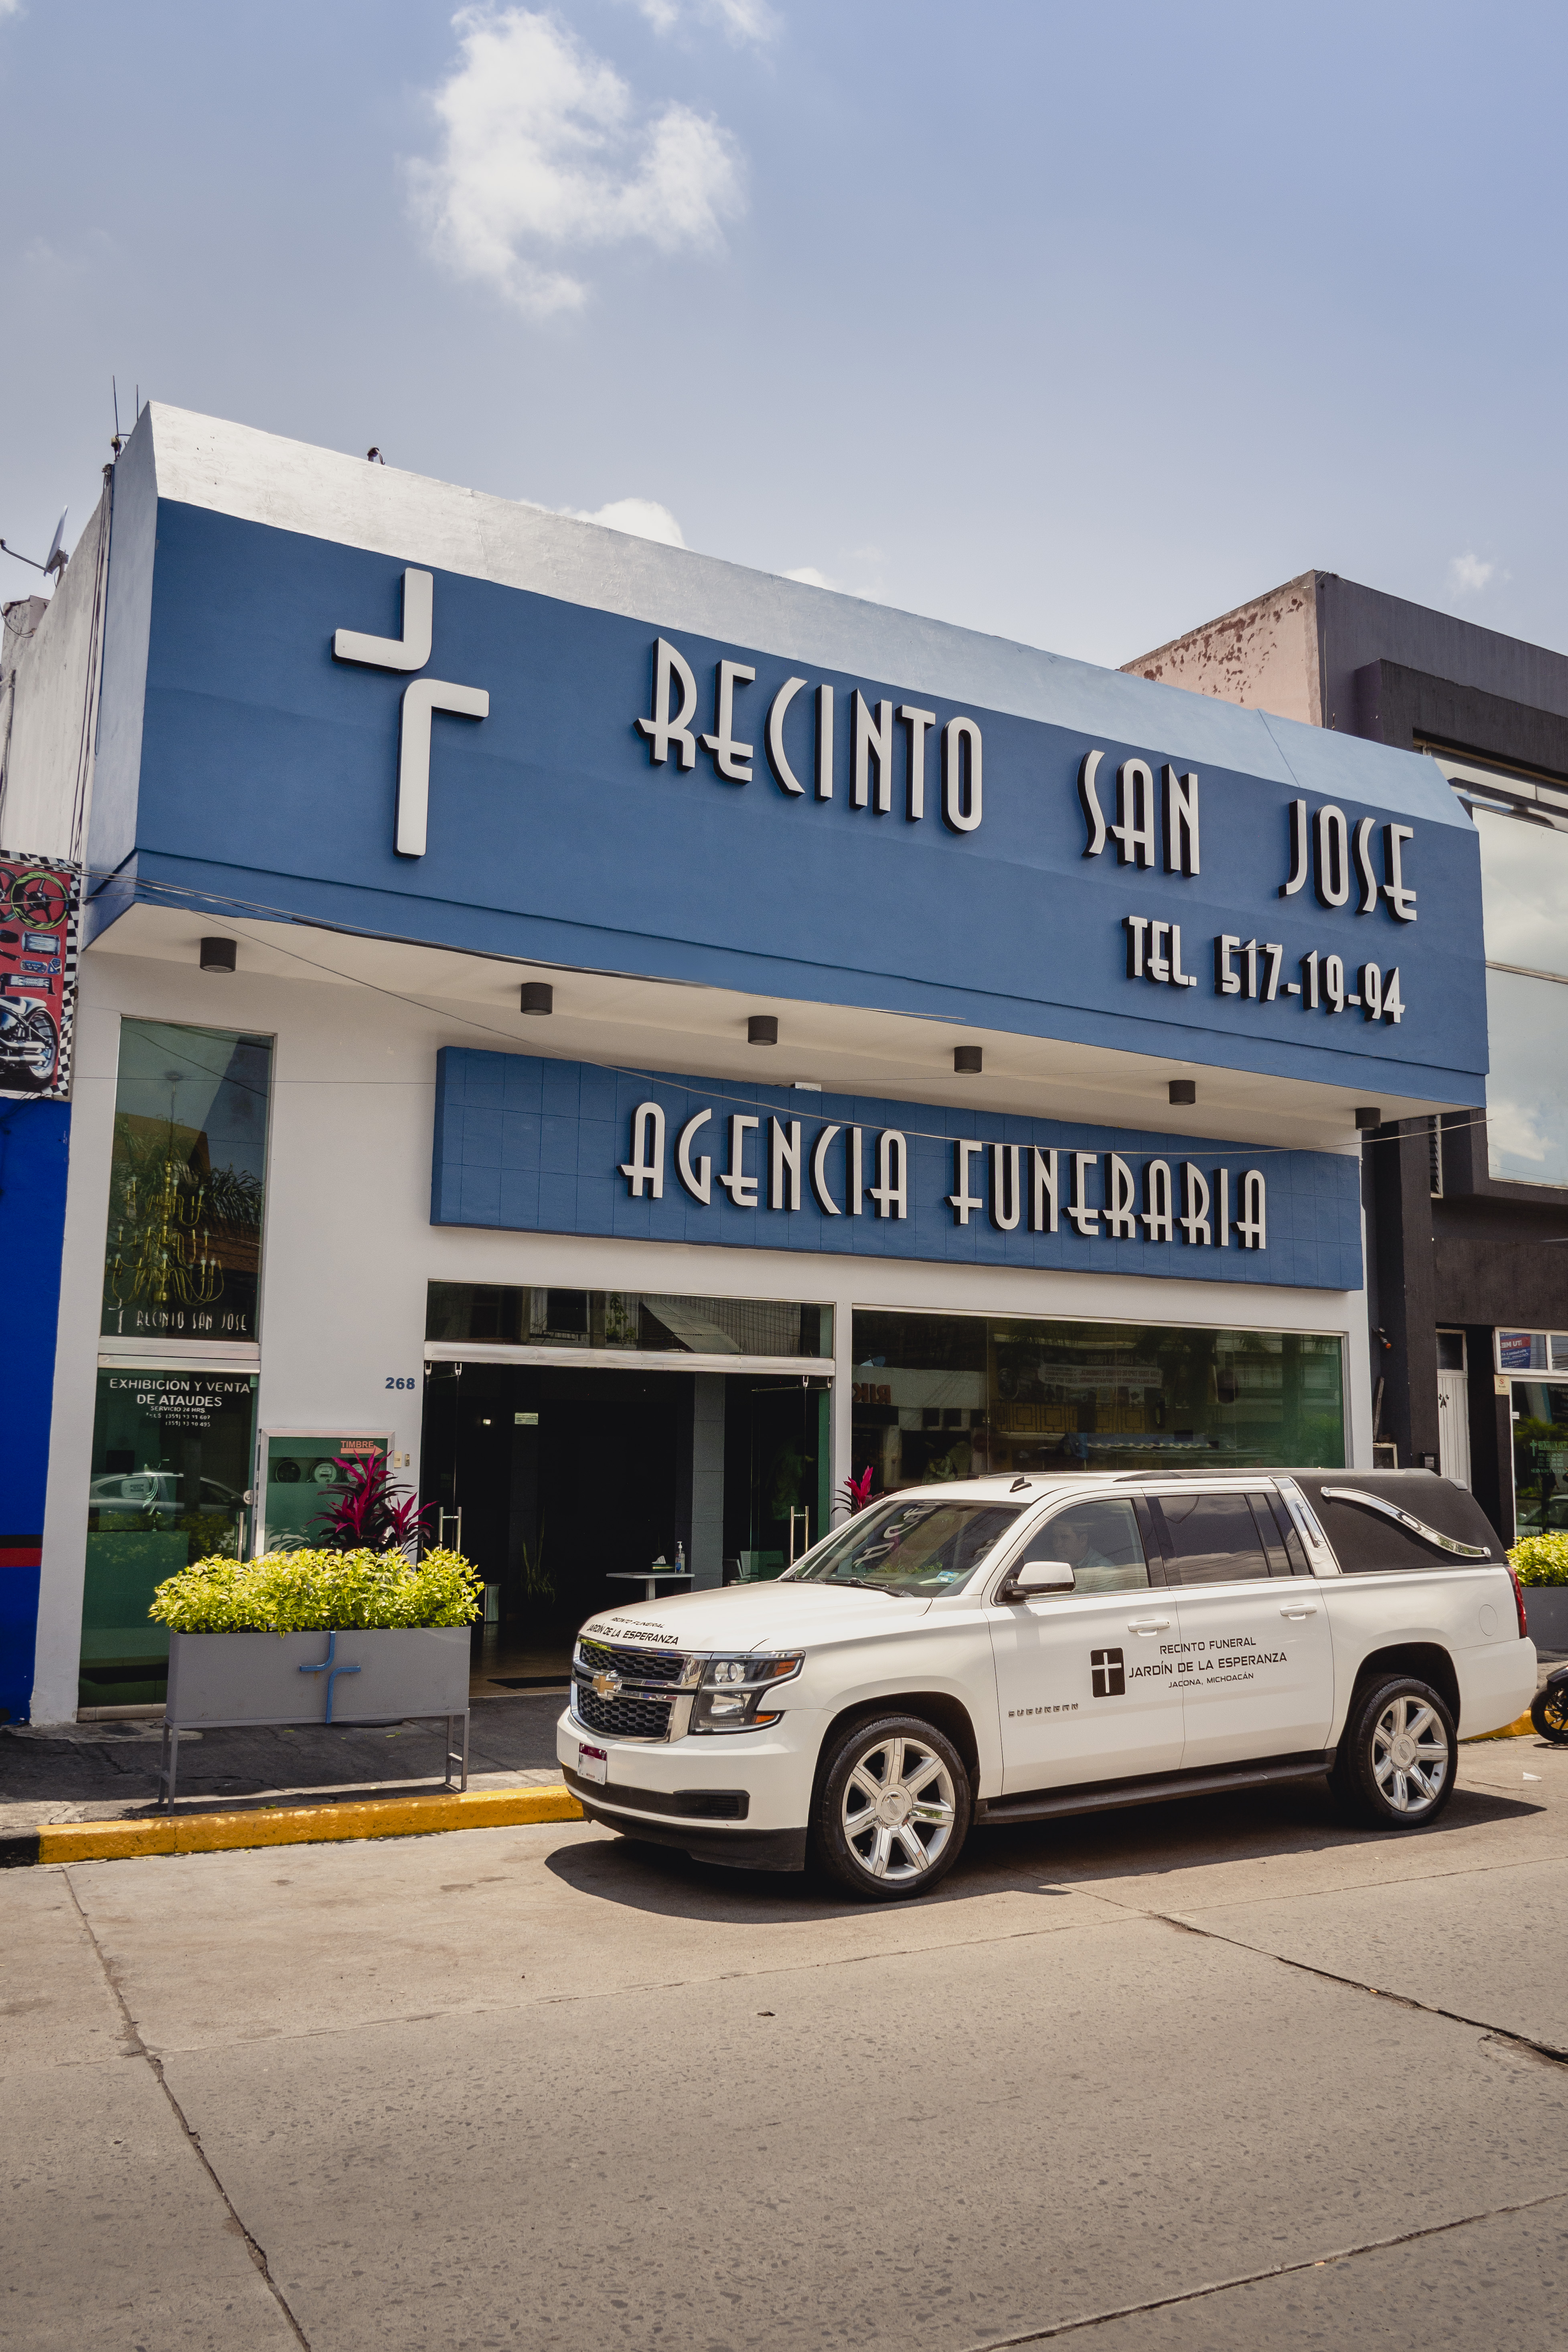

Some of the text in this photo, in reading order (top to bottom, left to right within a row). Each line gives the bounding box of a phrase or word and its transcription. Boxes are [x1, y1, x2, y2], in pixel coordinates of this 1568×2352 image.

[633, 637, 1417, 923] RECINTO SAN JOSE
[1121, 915, 1406, 1024] TEL. 517-19-94
[616, 1102, 1266, 1250] AGENCIA FUNERARIA
[193, 1313, 212, 1330] SAN
[110, 1378, 250, 1393] EXHIBICIÓN Y VENTA
[385, 1377, 415, 1390] 268
[137, 1394, 222, 1407] DE ATAUDES
[587, 1623, 679, 1645] JARDÍN DE LA ESPERANZA
[1160, 1637, 1256, 1655] RECINTO FUNERAL
[1128, 1652, 1287, 1678] JARDÍN DE LA ESPERANZA
[1169, 1671, 1254, 1688] JACONA, MICHOACÁN
